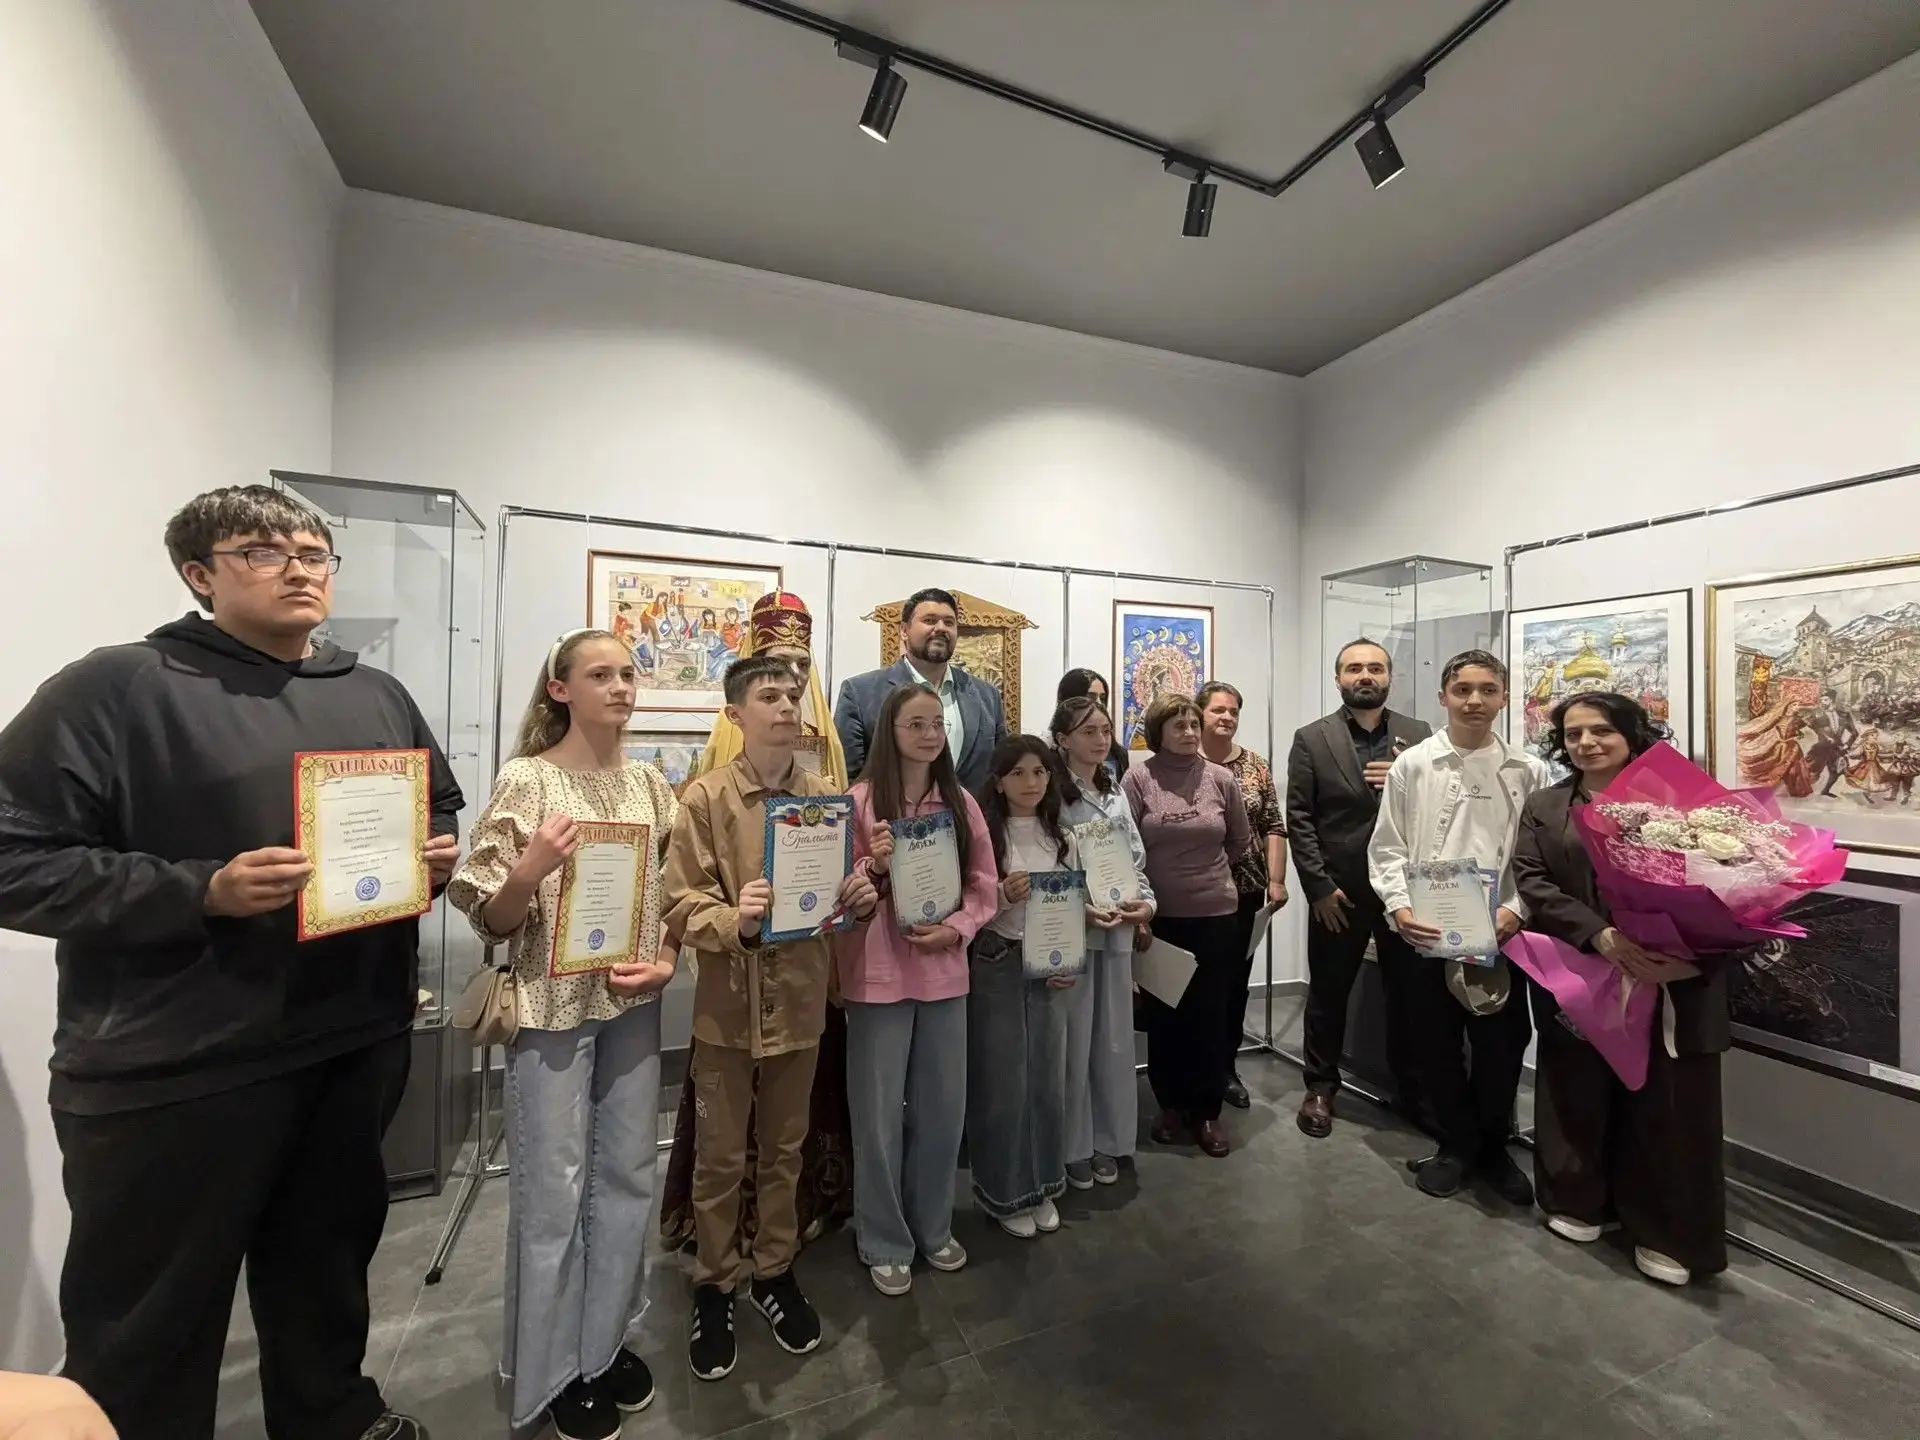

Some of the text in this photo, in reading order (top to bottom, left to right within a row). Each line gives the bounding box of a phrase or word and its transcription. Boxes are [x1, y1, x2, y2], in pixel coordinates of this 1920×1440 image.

[326, 758, 406, 776] ДИПЛОМ
[584, 829, 634, 842] ДИПЛОМ
[782, 829, 838, 849] Грамота
